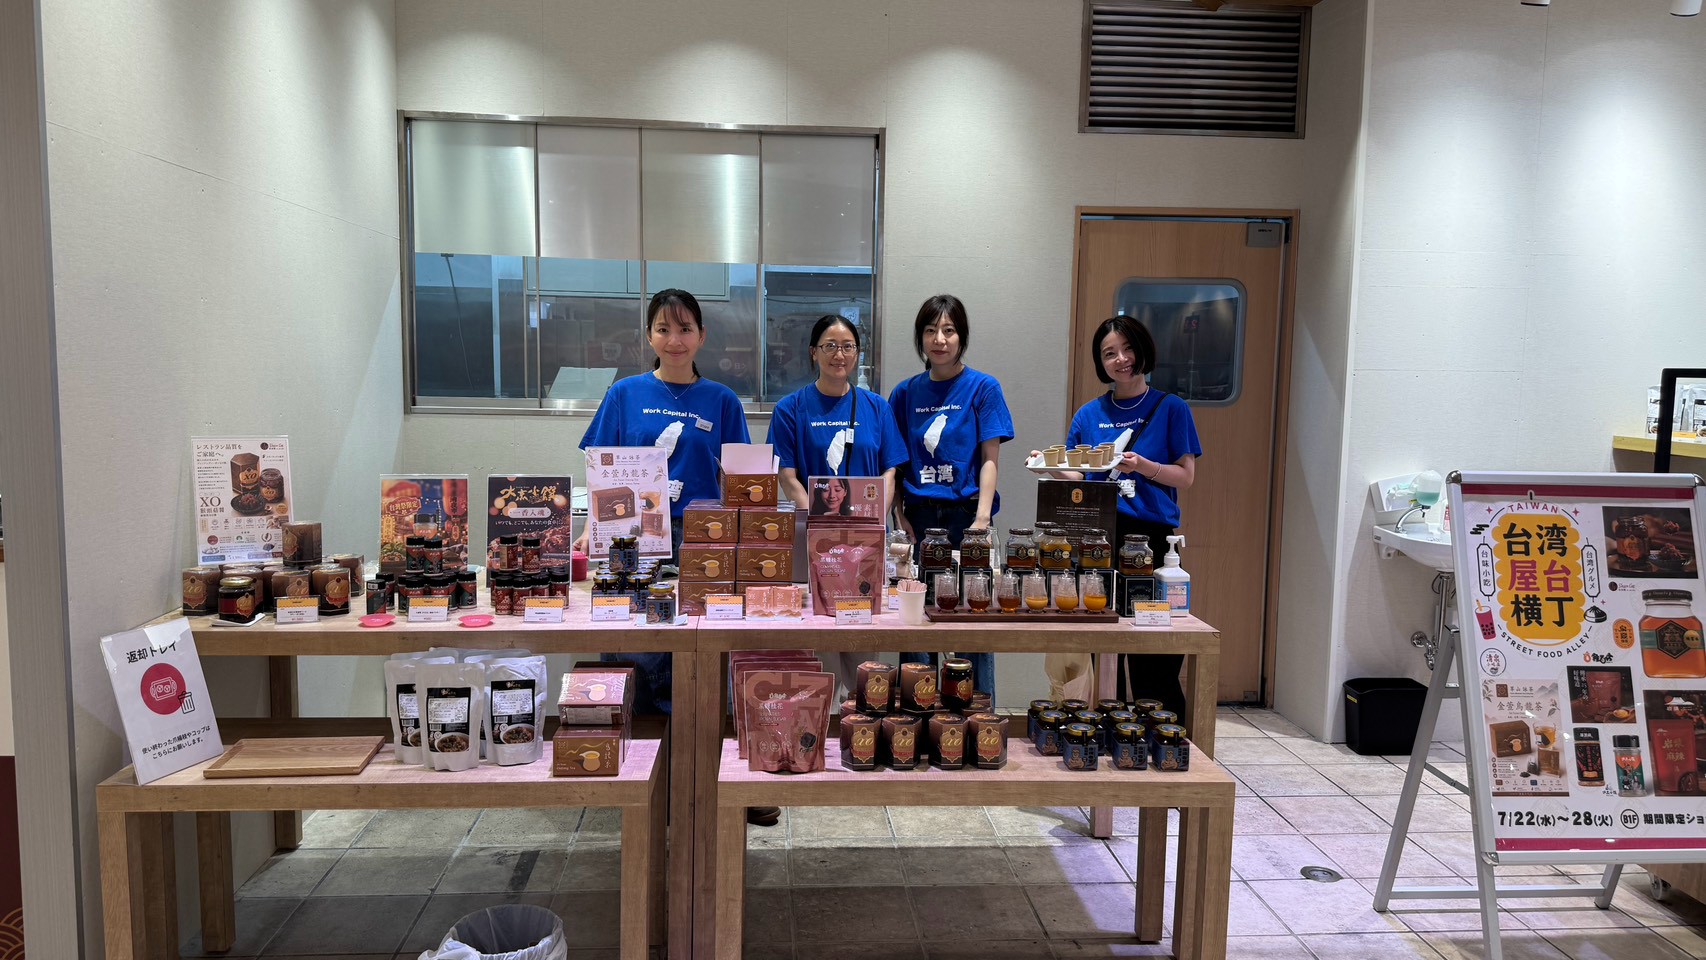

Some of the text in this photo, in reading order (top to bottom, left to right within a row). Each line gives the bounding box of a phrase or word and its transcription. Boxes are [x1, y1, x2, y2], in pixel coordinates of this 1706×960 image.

[662, 409, 687, 417] Capital
[919, 464, 954, 484] 台湾
[200, 496, 221, 507] XO
[1508, 502, 1558, 513] TAIWAN
[1503, 522, 1567, 557] 台湾
[1508, 559, 1571, 592] 屋台
[1586, 551, 1595, 589] 台湾グルメ
[1510, 594, 1574, 627] 横丁
[126, 641, 177, 664] 返却トレイ
[1500, 632, 1534, 655] STREET
[1566, 634, 1590, 655] ALLEY
[153, 737, 203, 759] こちらにお願いします。
[1623, 813, 1637, 824] B1F
[1643, 813, 1705, 825] 期間限定ショ
